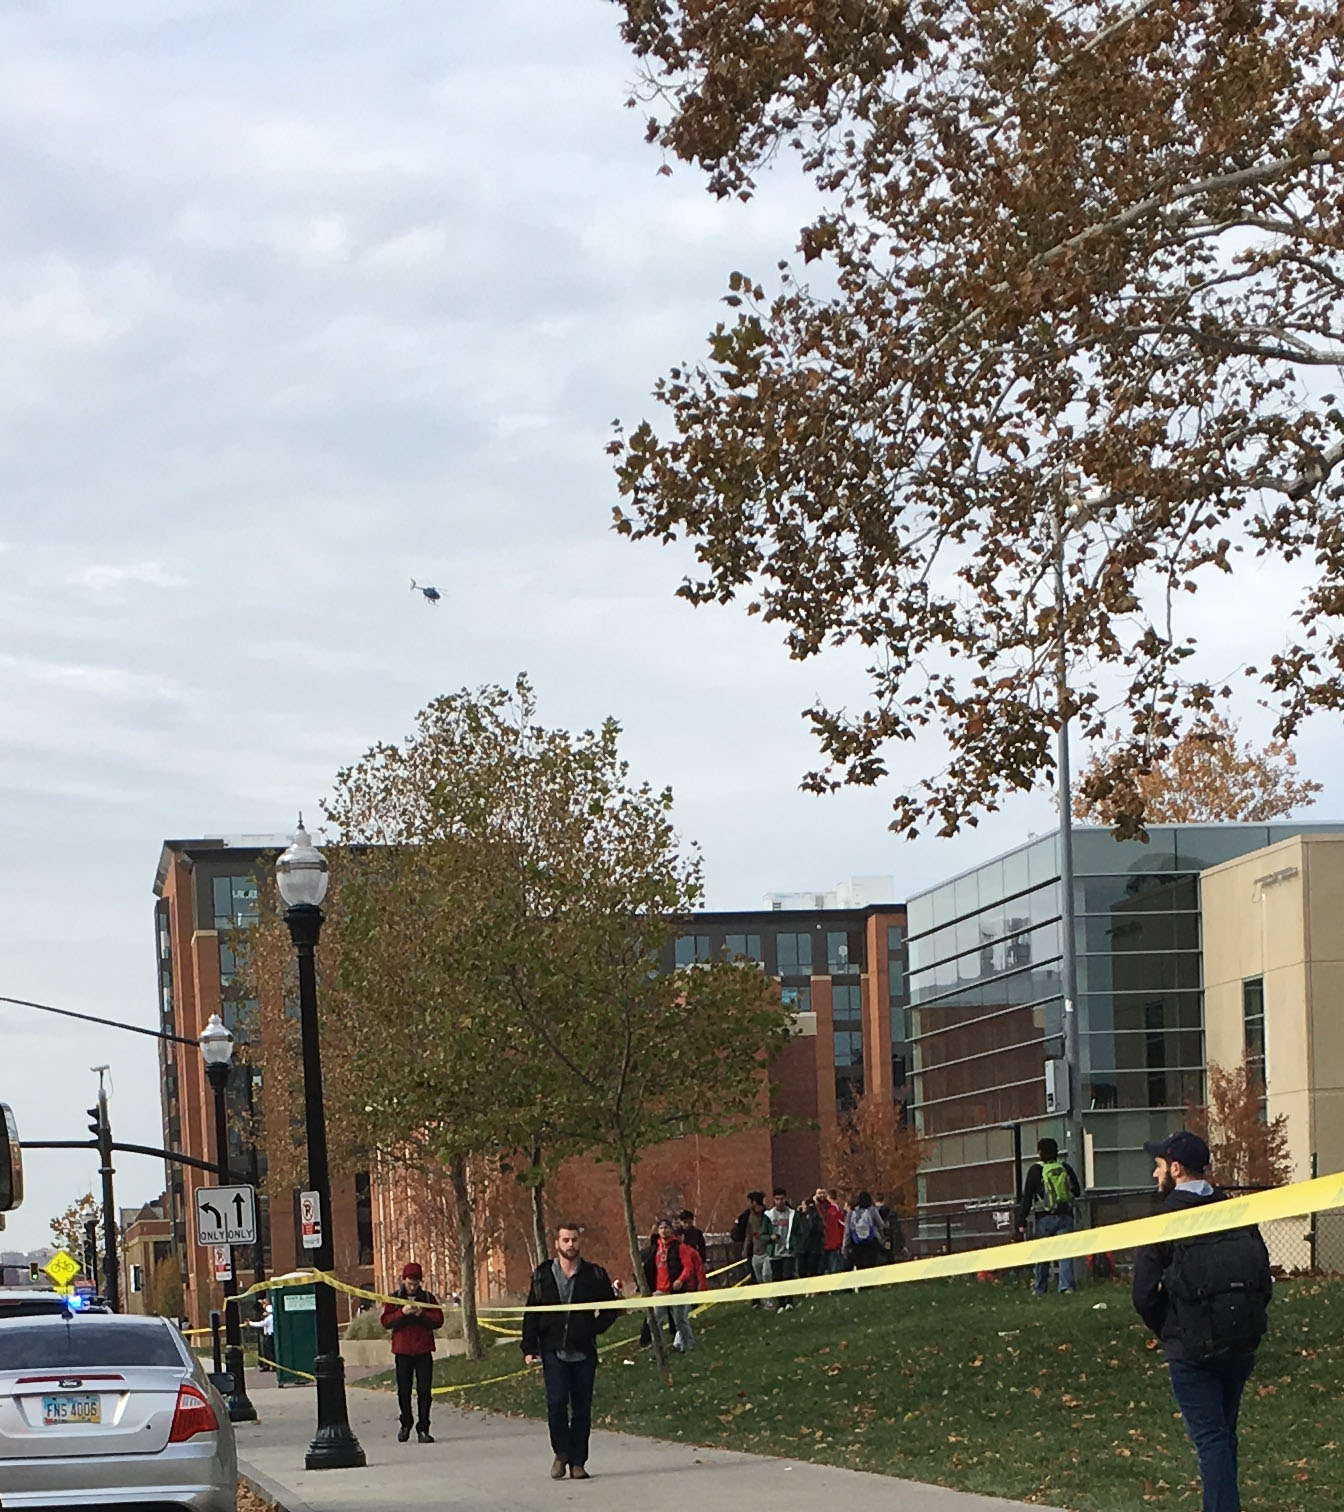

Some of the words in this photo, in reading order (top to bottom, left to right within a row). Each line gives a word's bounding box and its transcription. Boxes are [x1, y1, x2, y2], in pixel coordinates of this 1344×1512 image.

[200, 1230, 225, 1241] ONLY
[228, 1229, 254, 1240] ONLY
[47, 1403, 68, 1417] FNS
[70, 1401, 97, 1416] 4006
